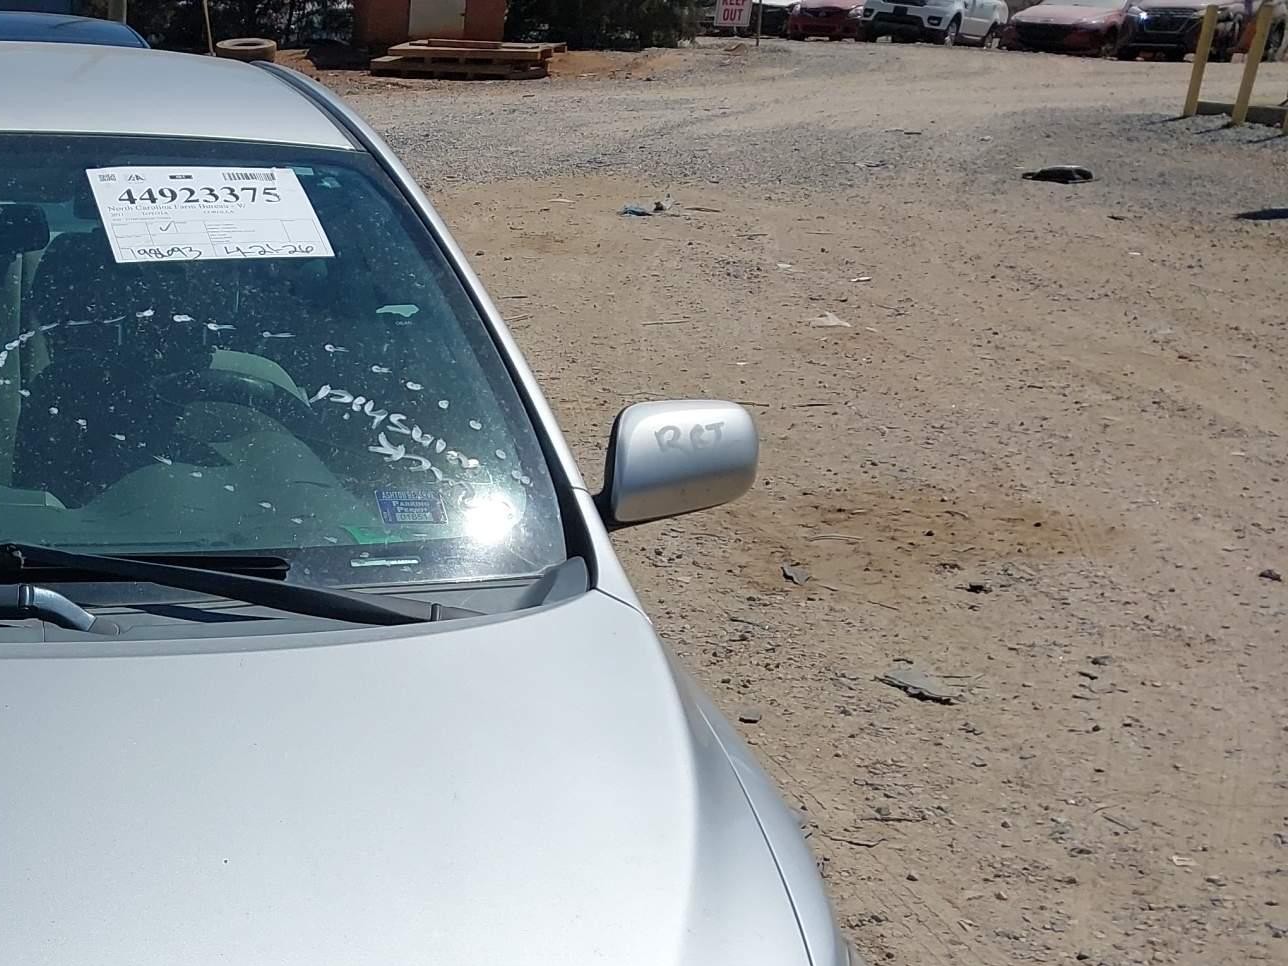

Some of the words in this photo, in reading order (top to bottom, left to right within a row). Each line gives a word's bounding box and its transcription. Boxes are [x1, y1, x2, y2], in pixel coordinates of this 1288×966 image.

[723, 9, 744, 21] OUT
[118, 186, 281, 205] 44923375
[108, 205, 133, 213] North
